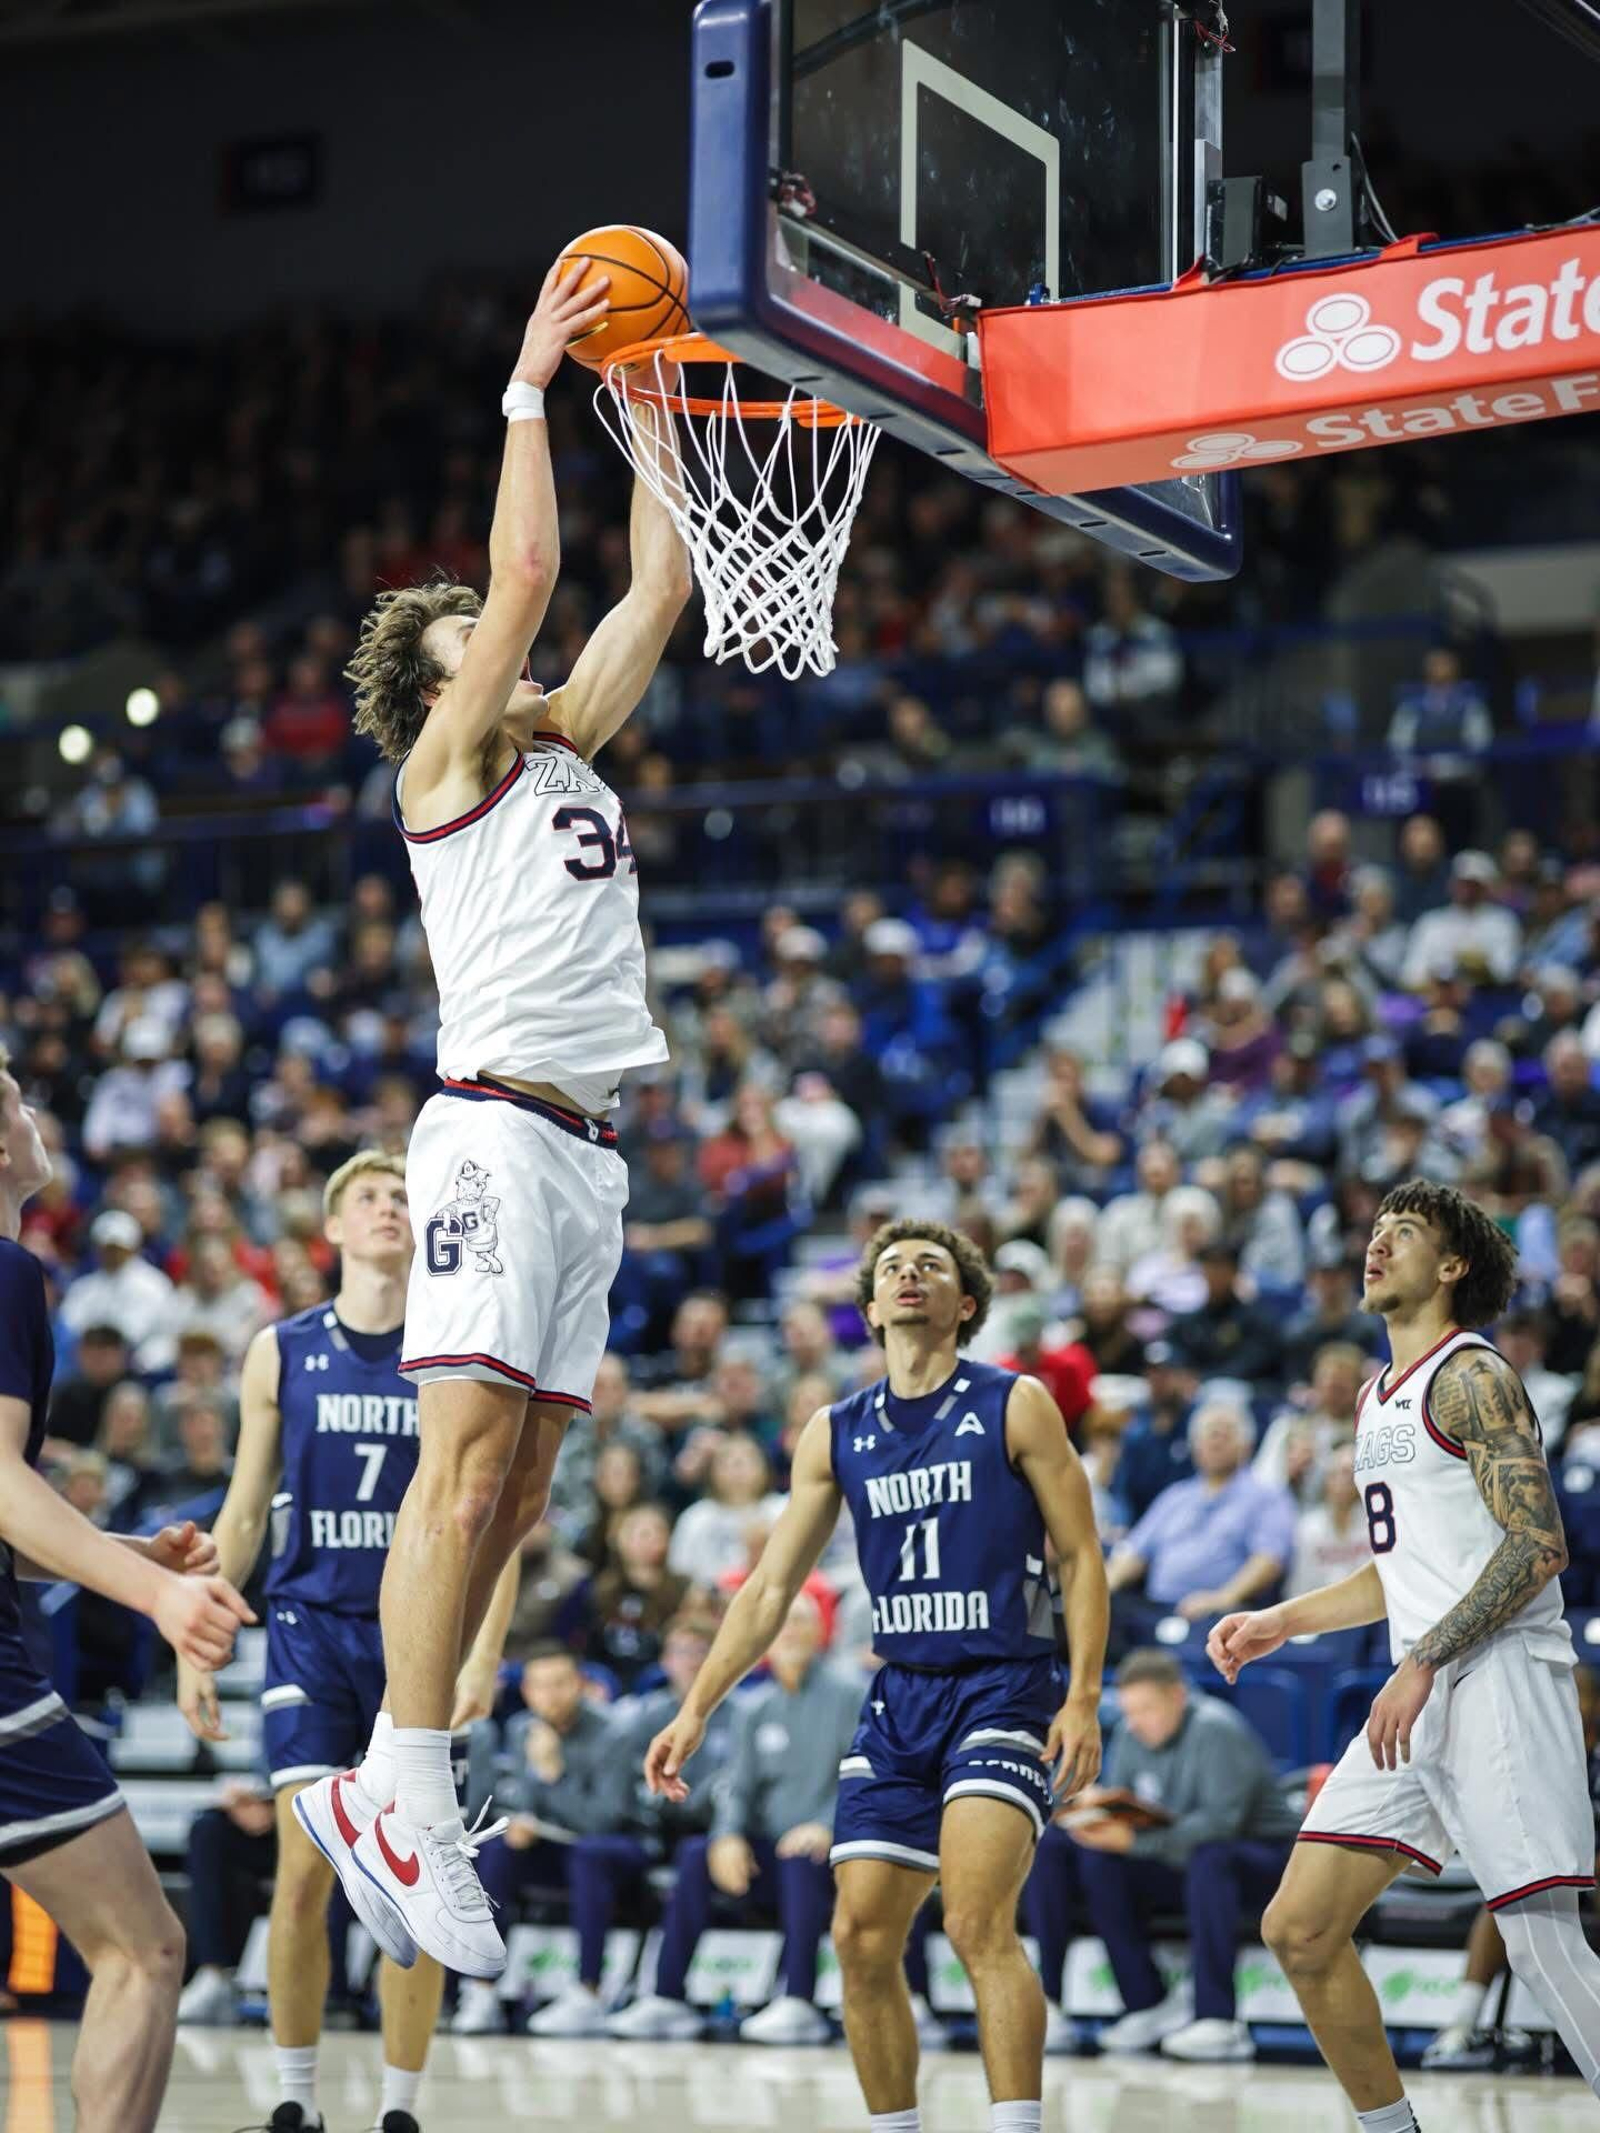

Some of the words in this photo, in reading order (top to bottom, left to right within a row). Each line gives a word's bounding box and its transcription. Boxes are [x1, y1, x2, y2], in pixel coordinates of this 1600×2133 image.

[1305, 391, 1547, 448] State
[551, 807, 638, 881] 34
[316, 1394, 420, 1435] NORTH
[354, 1443, 388, 1501] 7
[1353, 1423, 1416, 1474] AGS
[864, 1460, 972, 1519] NORTH
[1365, 1481, 1397, 1554] 8
[309, 1510, 398, 1549] FLORI
[899, 1517, 941, 1582] 11
